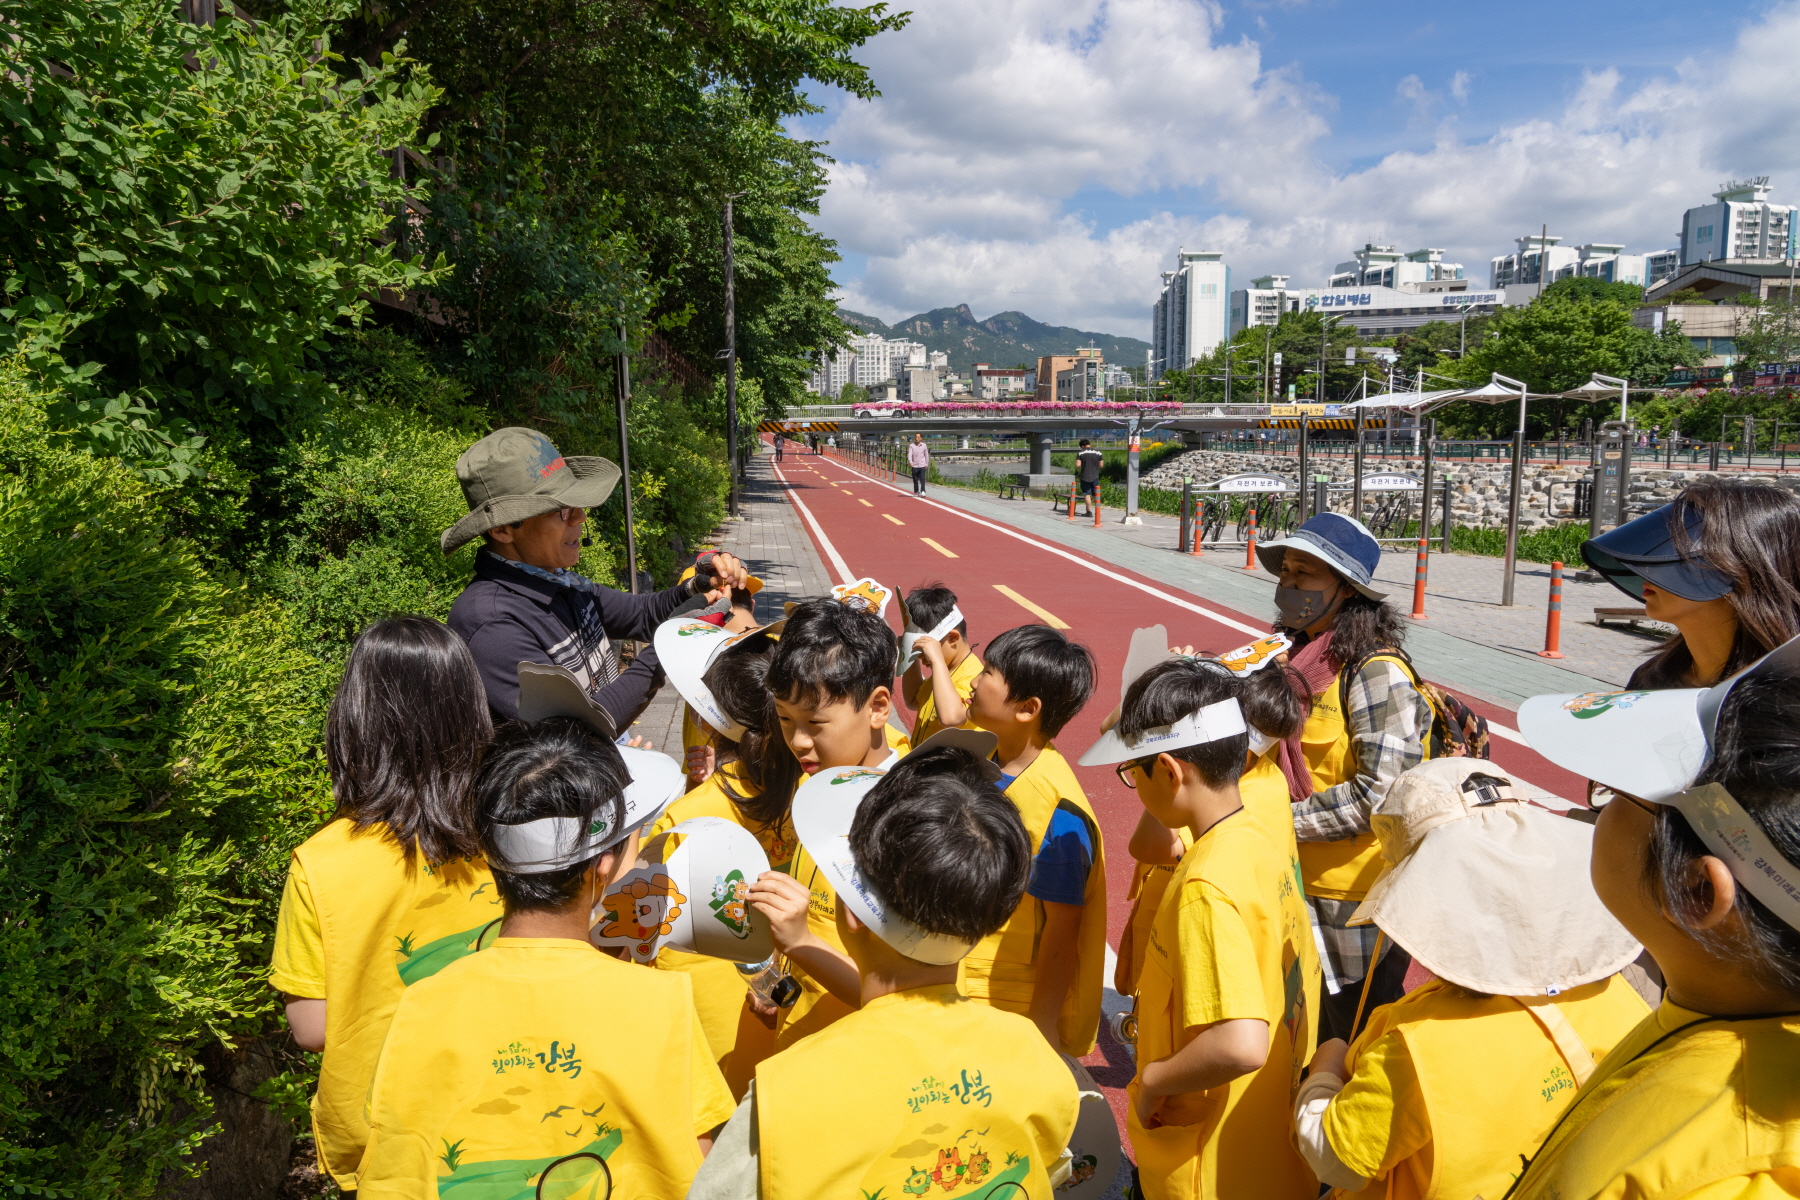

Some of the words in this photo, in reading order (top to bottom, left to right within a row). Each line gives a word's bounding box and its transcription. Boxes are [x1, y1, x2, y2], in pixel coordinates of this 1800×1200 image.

[1321, 293, 1371, 306] 한일병원
[1260, 479, 1280, 487] 보관대
[850, 877, 888, 924] 강북미래교육지구
[535, 1040, 582, 1079] 강북
[949, 1069, 992, 1108] 강북
